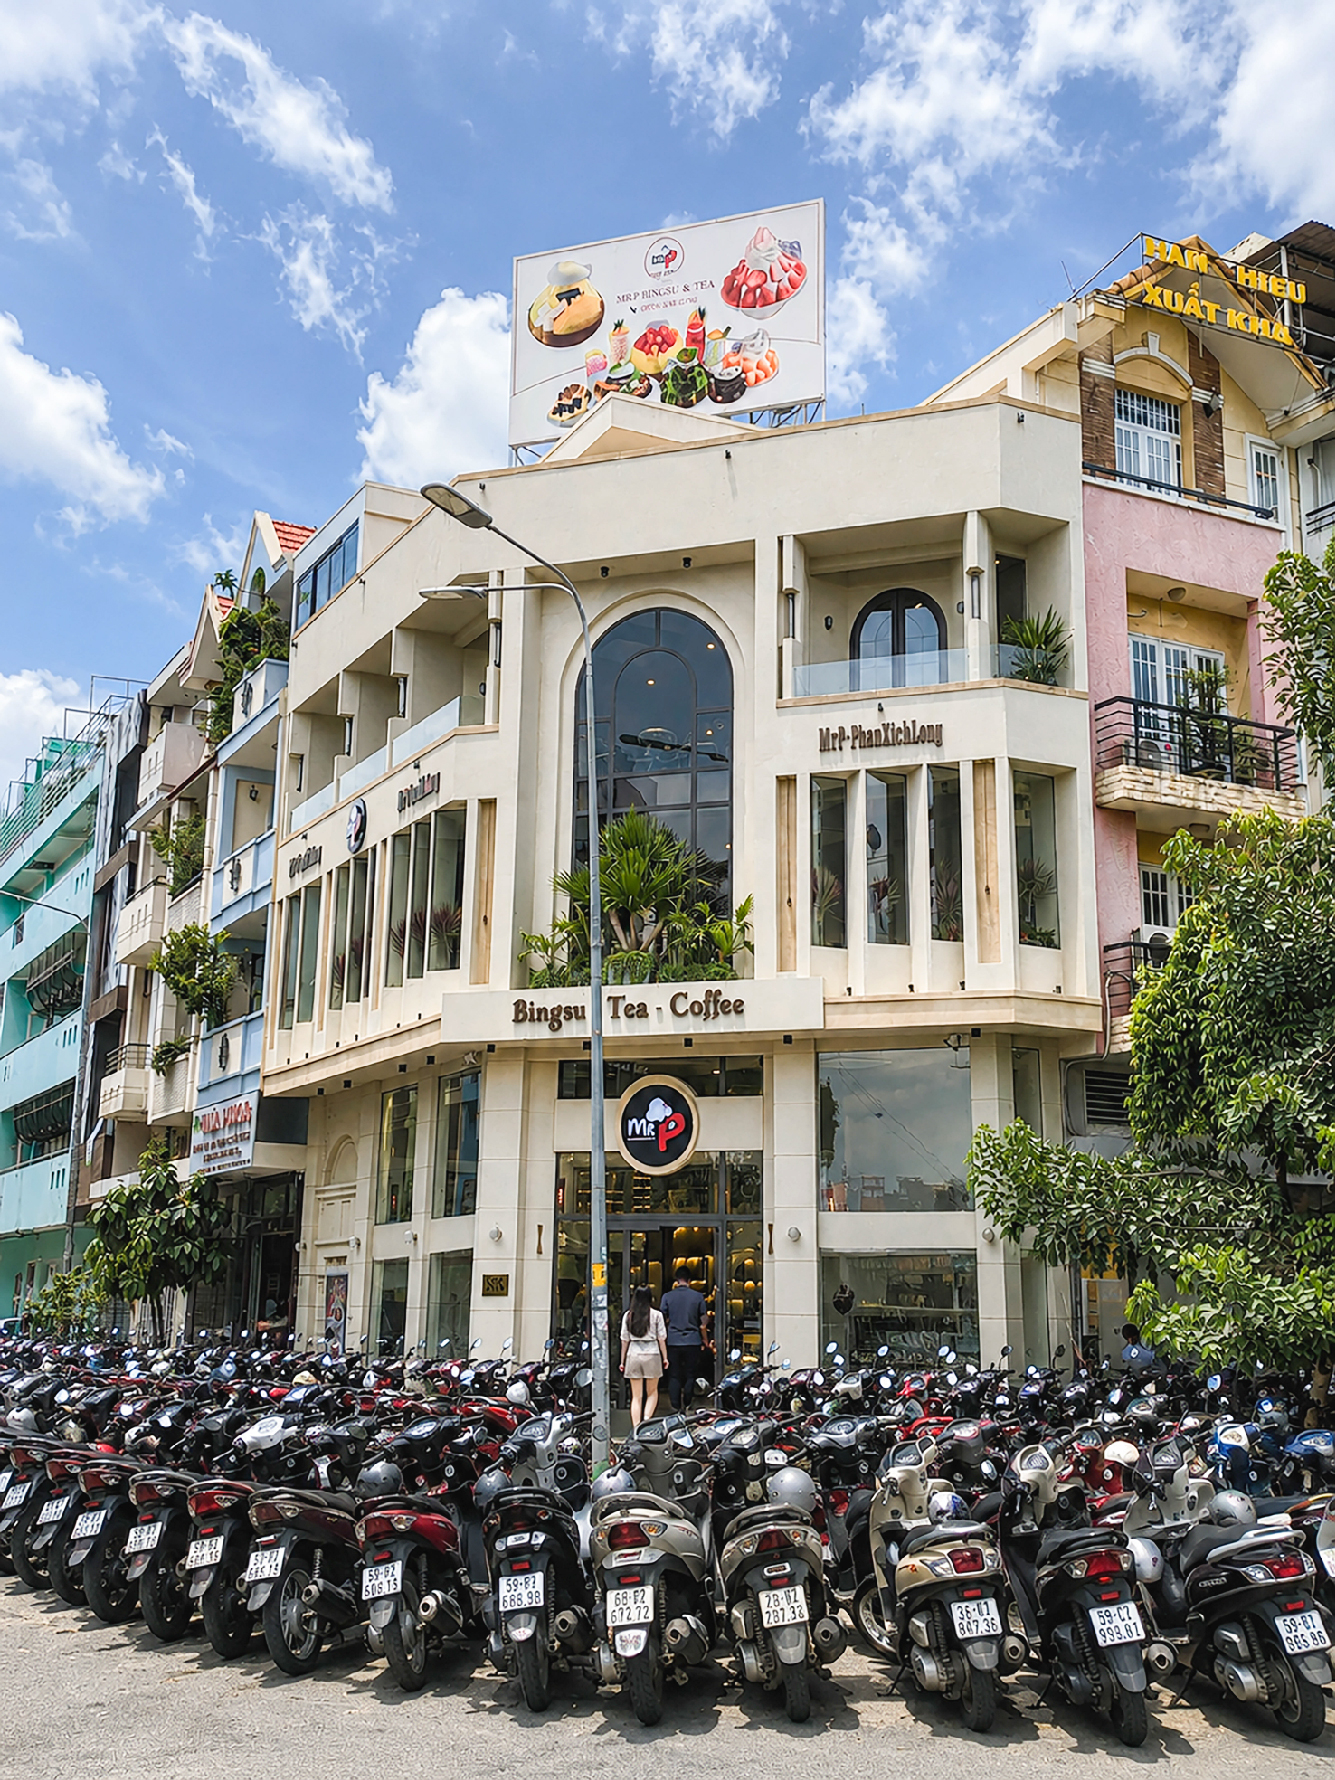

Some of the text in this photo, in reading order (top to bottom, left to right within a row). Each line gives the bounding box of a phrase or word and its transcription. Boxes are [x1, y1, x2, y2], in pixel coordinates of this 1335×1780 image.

[694, 279, 715, 290] TEA
[512, 998, 587, 1032] Bingsu
[607, 995, 650, 1019] Tea
[669, 988, 745, 1022] Coffee
